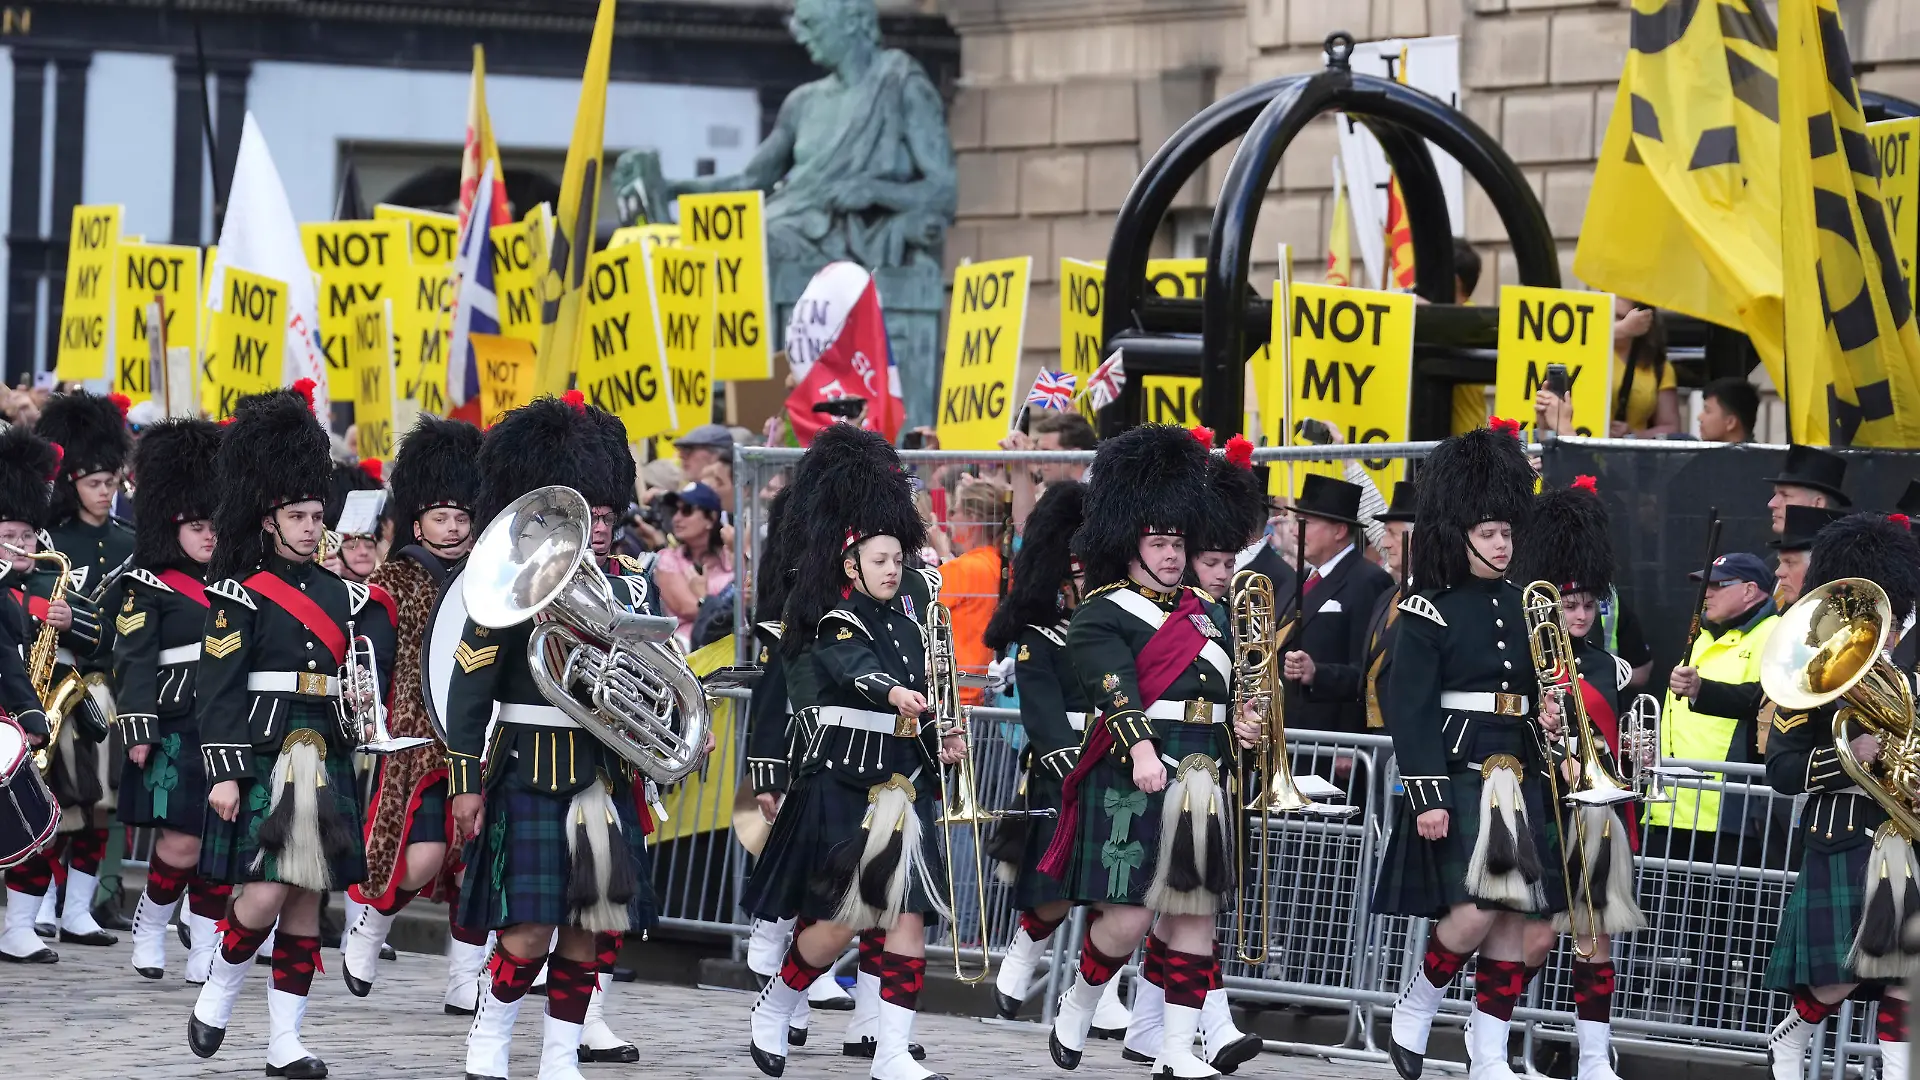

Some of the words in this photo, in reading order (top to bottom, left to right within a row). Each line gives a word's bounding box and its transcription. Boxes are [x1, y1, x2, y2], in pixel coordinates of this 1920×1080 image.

[77, 216, 111, 250] NOT
[411, 223, 456, 260] OT
[691, 204, 746, 242] NOT
[317, 232, 389, 267] NOT
[490, 234, 529, 275] NO
[76, 265, 102, 299] MY
[127, 255, 183, 293] NOT
[662, 257, 706, 297] NOT
[962, 271, 1015, 313] NOT
[231, 278, 277, 325] NOT
[1294, 296, 1391, 346] NOT
[64, 316, 103, 350] KING
[356, 312, 381, 353] NOT
[592, 312, 631, 361] MY
[666, 312, 700, 350] MY
[1517, 299, 1594, 346] NOT
[233, 334, 268, 376] MY
[960, 326, 1002, 367] MY
[361, 365, 380, 406] MY
[486, 358, 519, 384] NOT
[588, 364, 657, 415] KING
[671, 367, 706, 408] ING
[1301, 358, 1376, 406] MY
[943, 381, 1005, 425] KING
[357, 421, 391, 457] KING
